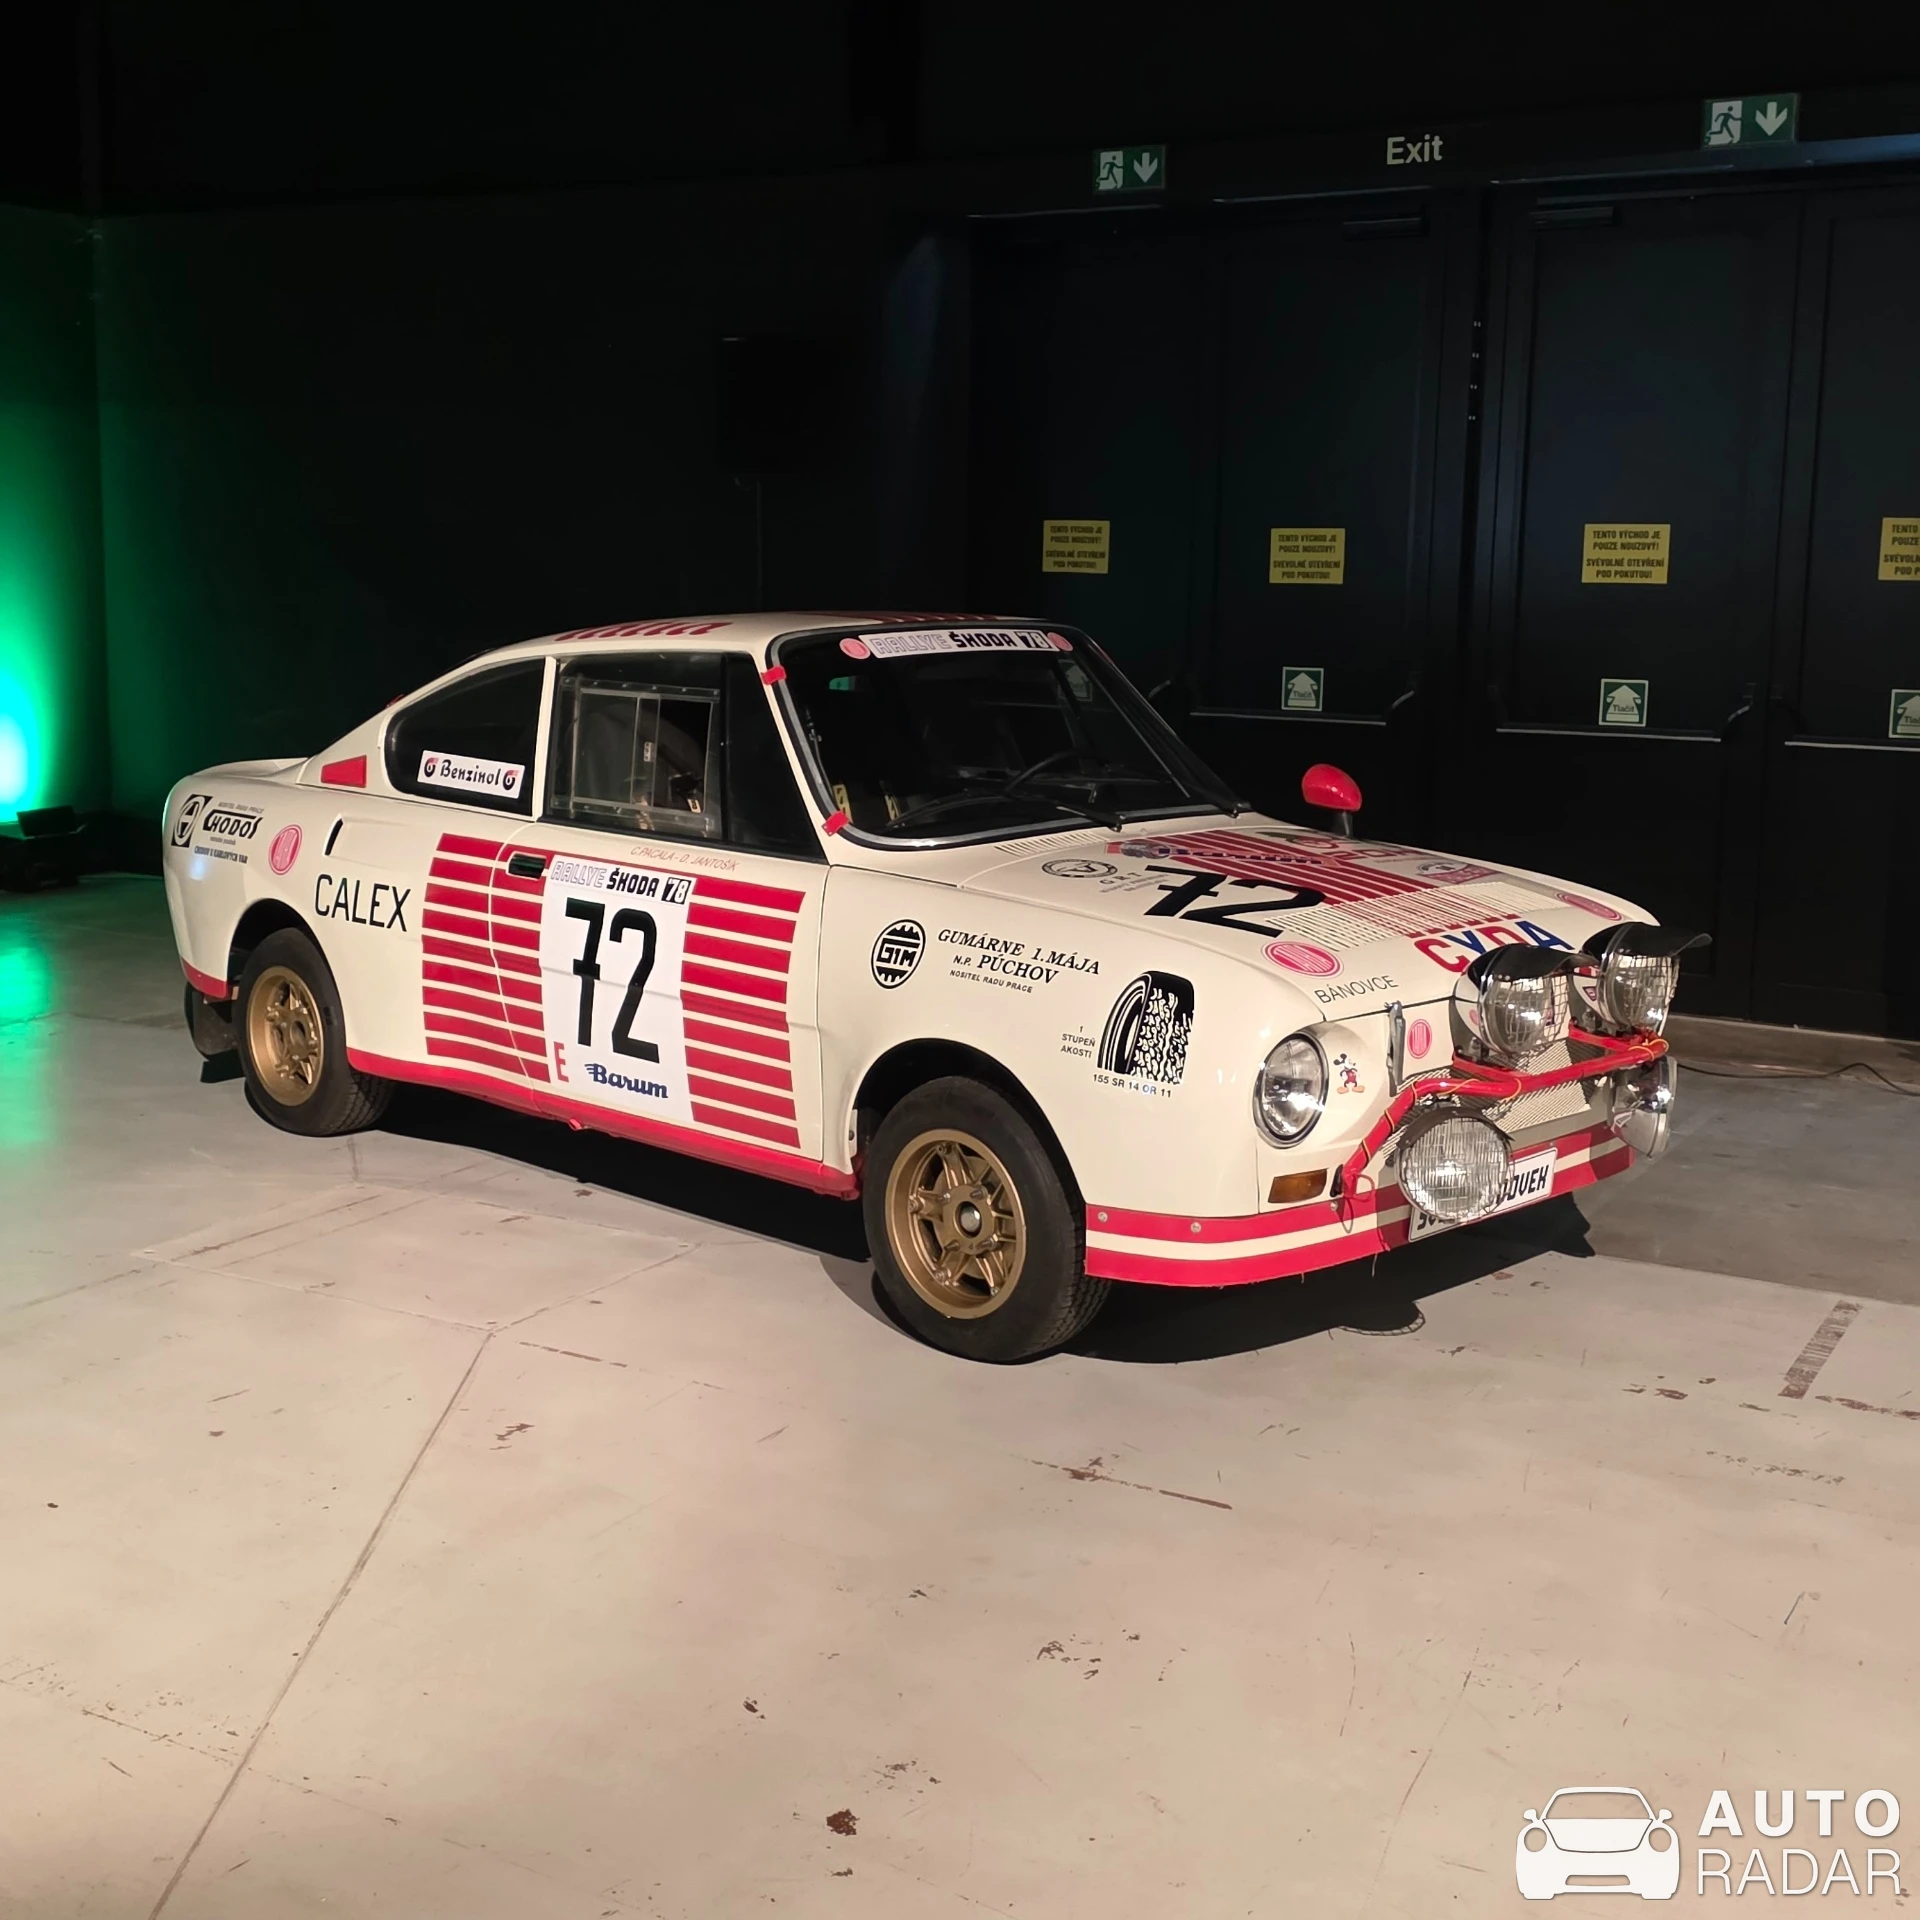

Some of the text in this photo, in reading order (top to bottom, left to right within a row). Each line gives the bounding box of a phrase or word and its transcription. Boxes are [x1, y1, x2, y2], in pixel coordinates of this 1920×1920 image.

[1387, 133, 1443, 165] Exit
[1328, 534, 1336, 542] JE
[1593, 529, 1661, 539] TENTO VÝCHOD JE
[1892, 524, 1918, 533] TENTO
[1279, 545, 1300, 553] POUZE
[1593, 542, 1618, 550] POUZE
[1892, 537, 1919, 545] POUZE
[1282, 571, 1295, 579] POD
[1596, 570, 1653, 578] POD POKUTOU!
[870, 633, 951, 654] RALLYE
[949, 631, 1016, 648] ŠKODA
[1613, 704, 1635, 712] Tlačit
[440, 759, 502, 786] Benzinol
[203, 809, 264, 839] CHODOS
[551, 861, 607, 888] RALLYE
[606, 868, 660, 897] ŠKODA
[315, 873, 411, 932] CALEX
[1143, 864, 1328, 938] 72
[938, 928, 1025, 957] GUMÁRNE
[565, 897, 660, 1063] 72
[952, 953, 1059, 984] N.P. PÚCHOV
[949, 969, 1034, 994] NOSITEL RADU PRACE
[1314, 975, 1399, 1004] BÁNOVCE
[1060, 1045, 1092, 1059] AKOSTI
[1061, 1033, 1096, 1048] STUPEŇ
[553, 1041, 570, 1083] E
[584, 1063, 668, 1098] Barum
[1093, 1074, 1110, 1085] 155
[1111, 1078, 1126, 1088] SR
[1128, 1082, 1139, 1091] 14
[1160, 1088, 1172, 1098] 11
